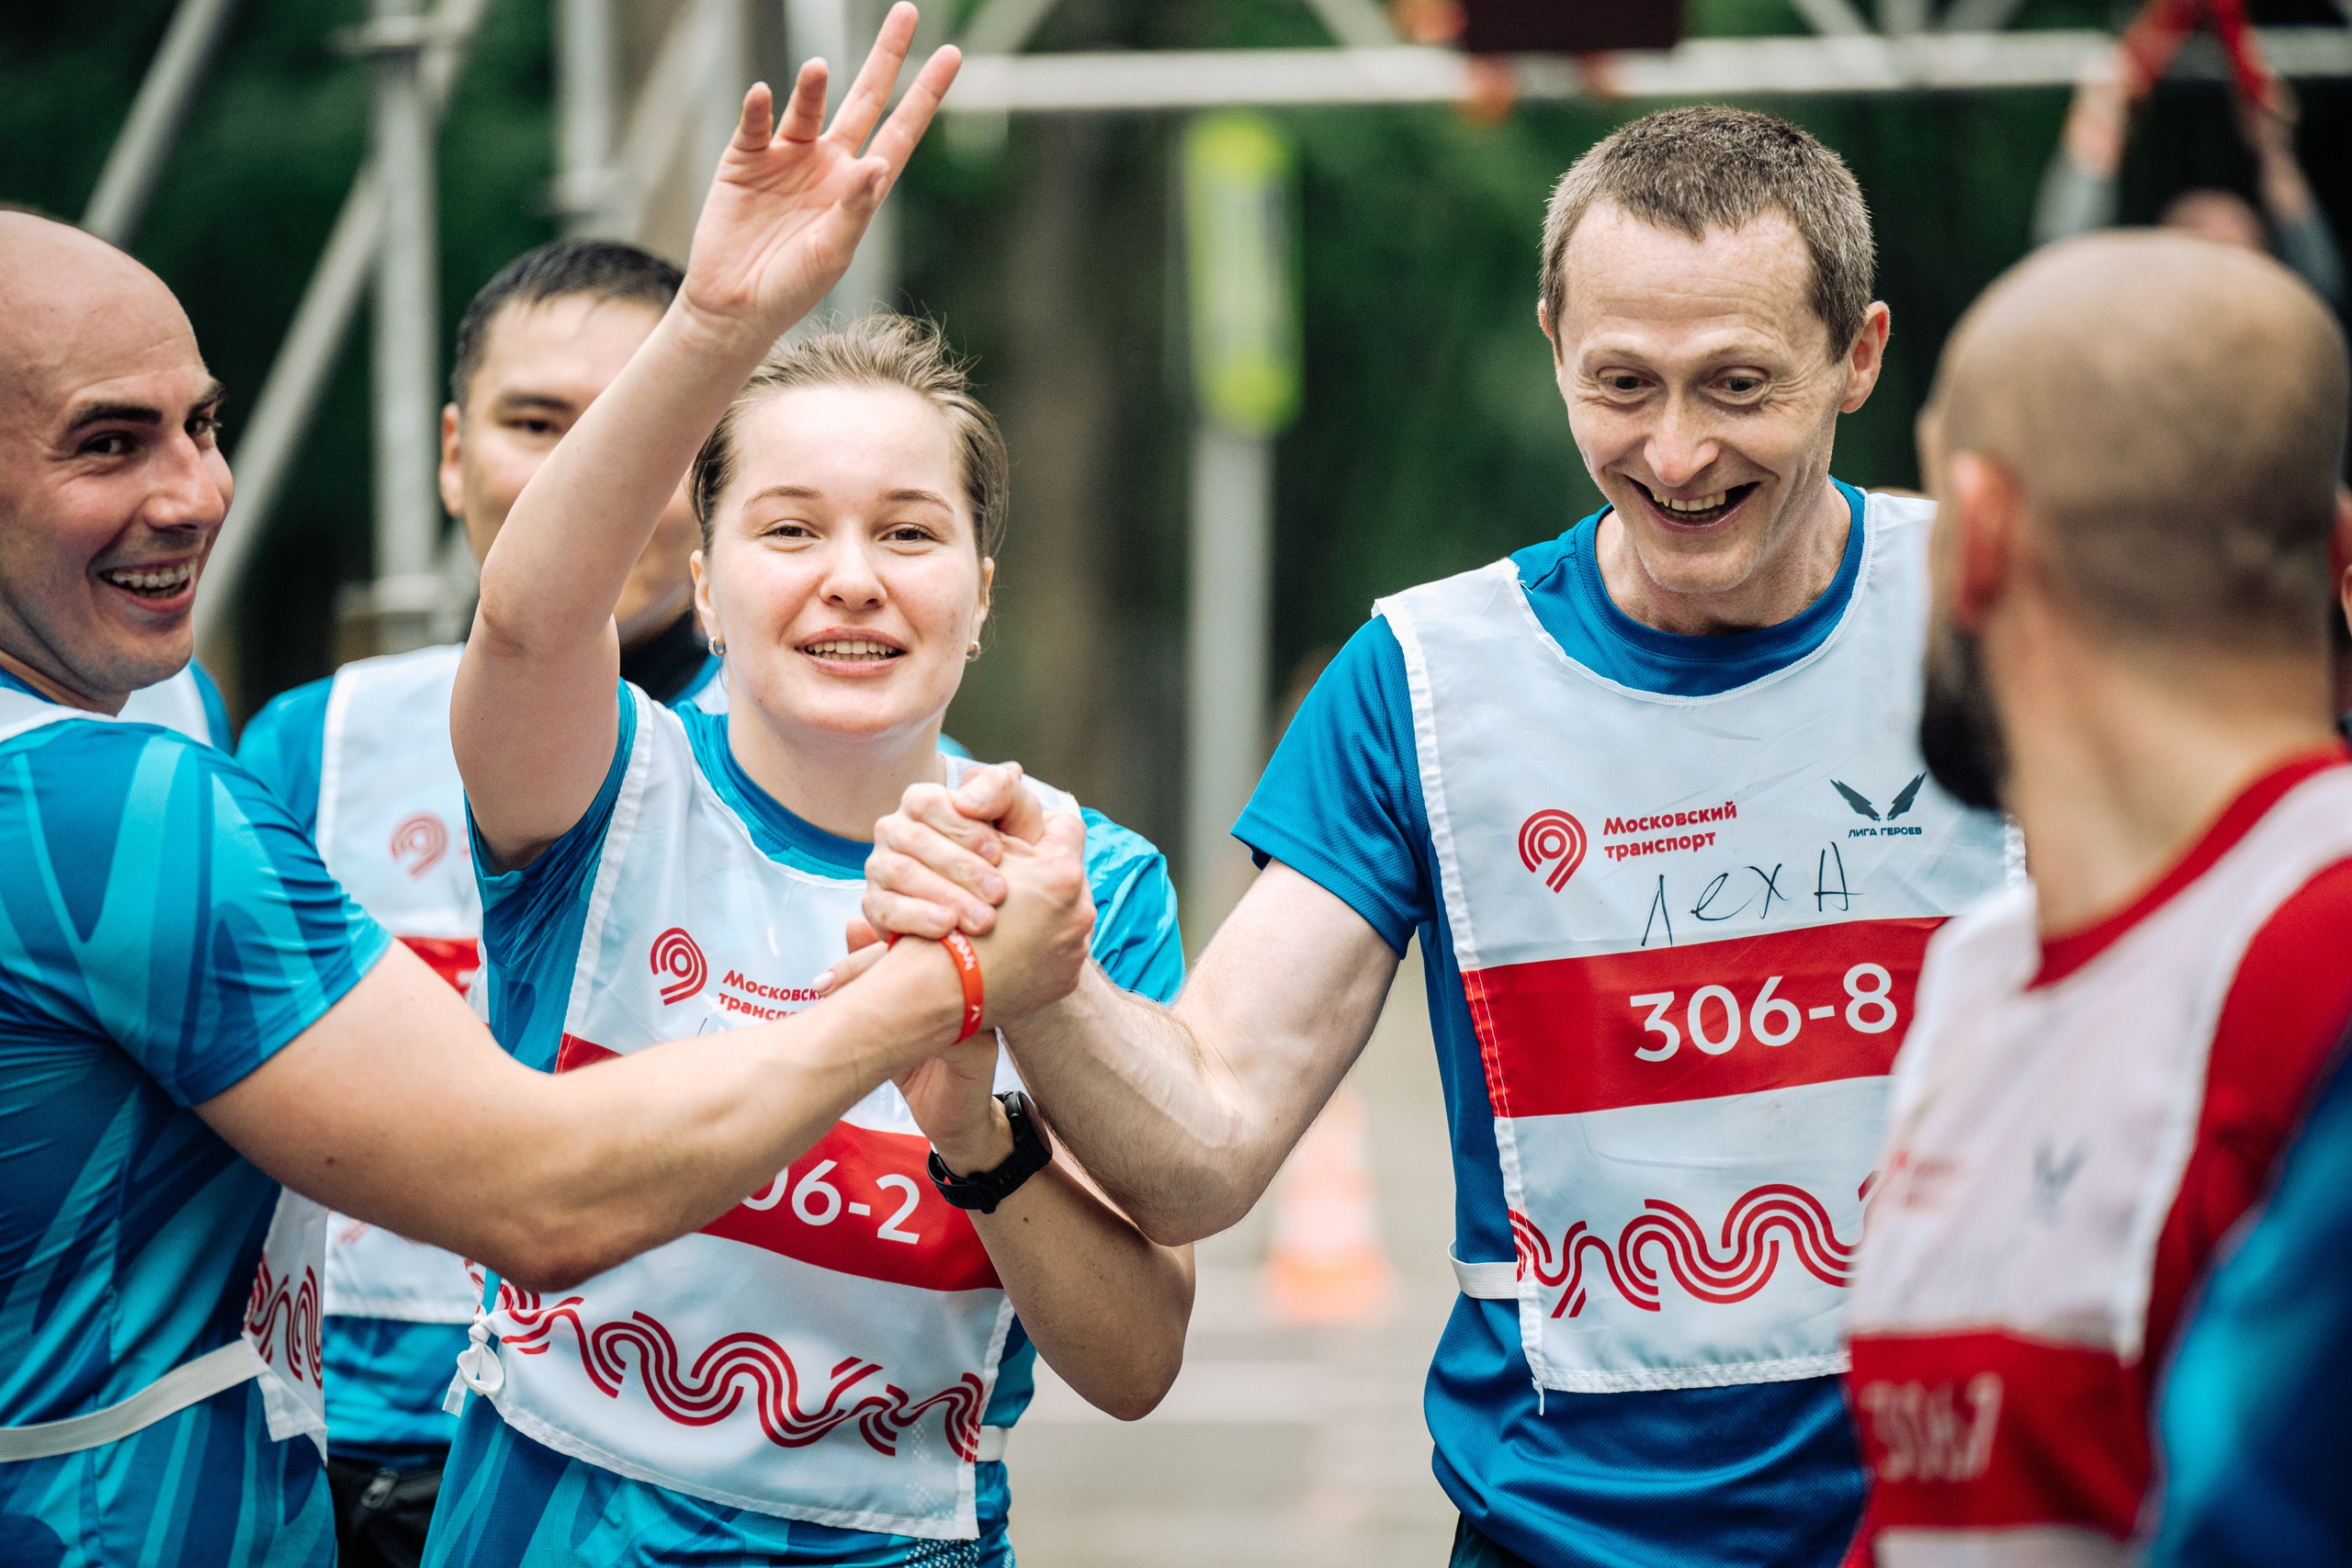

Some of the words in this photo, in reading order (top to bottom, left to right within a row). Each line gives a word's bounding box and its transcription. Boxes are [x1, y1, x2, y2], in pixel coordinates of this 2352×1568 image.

[1603, 800, 1737, 836] Московский
[1848, 828, 1877, 839] ЛИГА
[1880, 826, 1923, 836] ГЕРОЕВ
[1604, 831, 1716, 862] транспорт
[718, 992, 798, 1021] трансп
[1629, 962, 1897, 1063] 306-8
